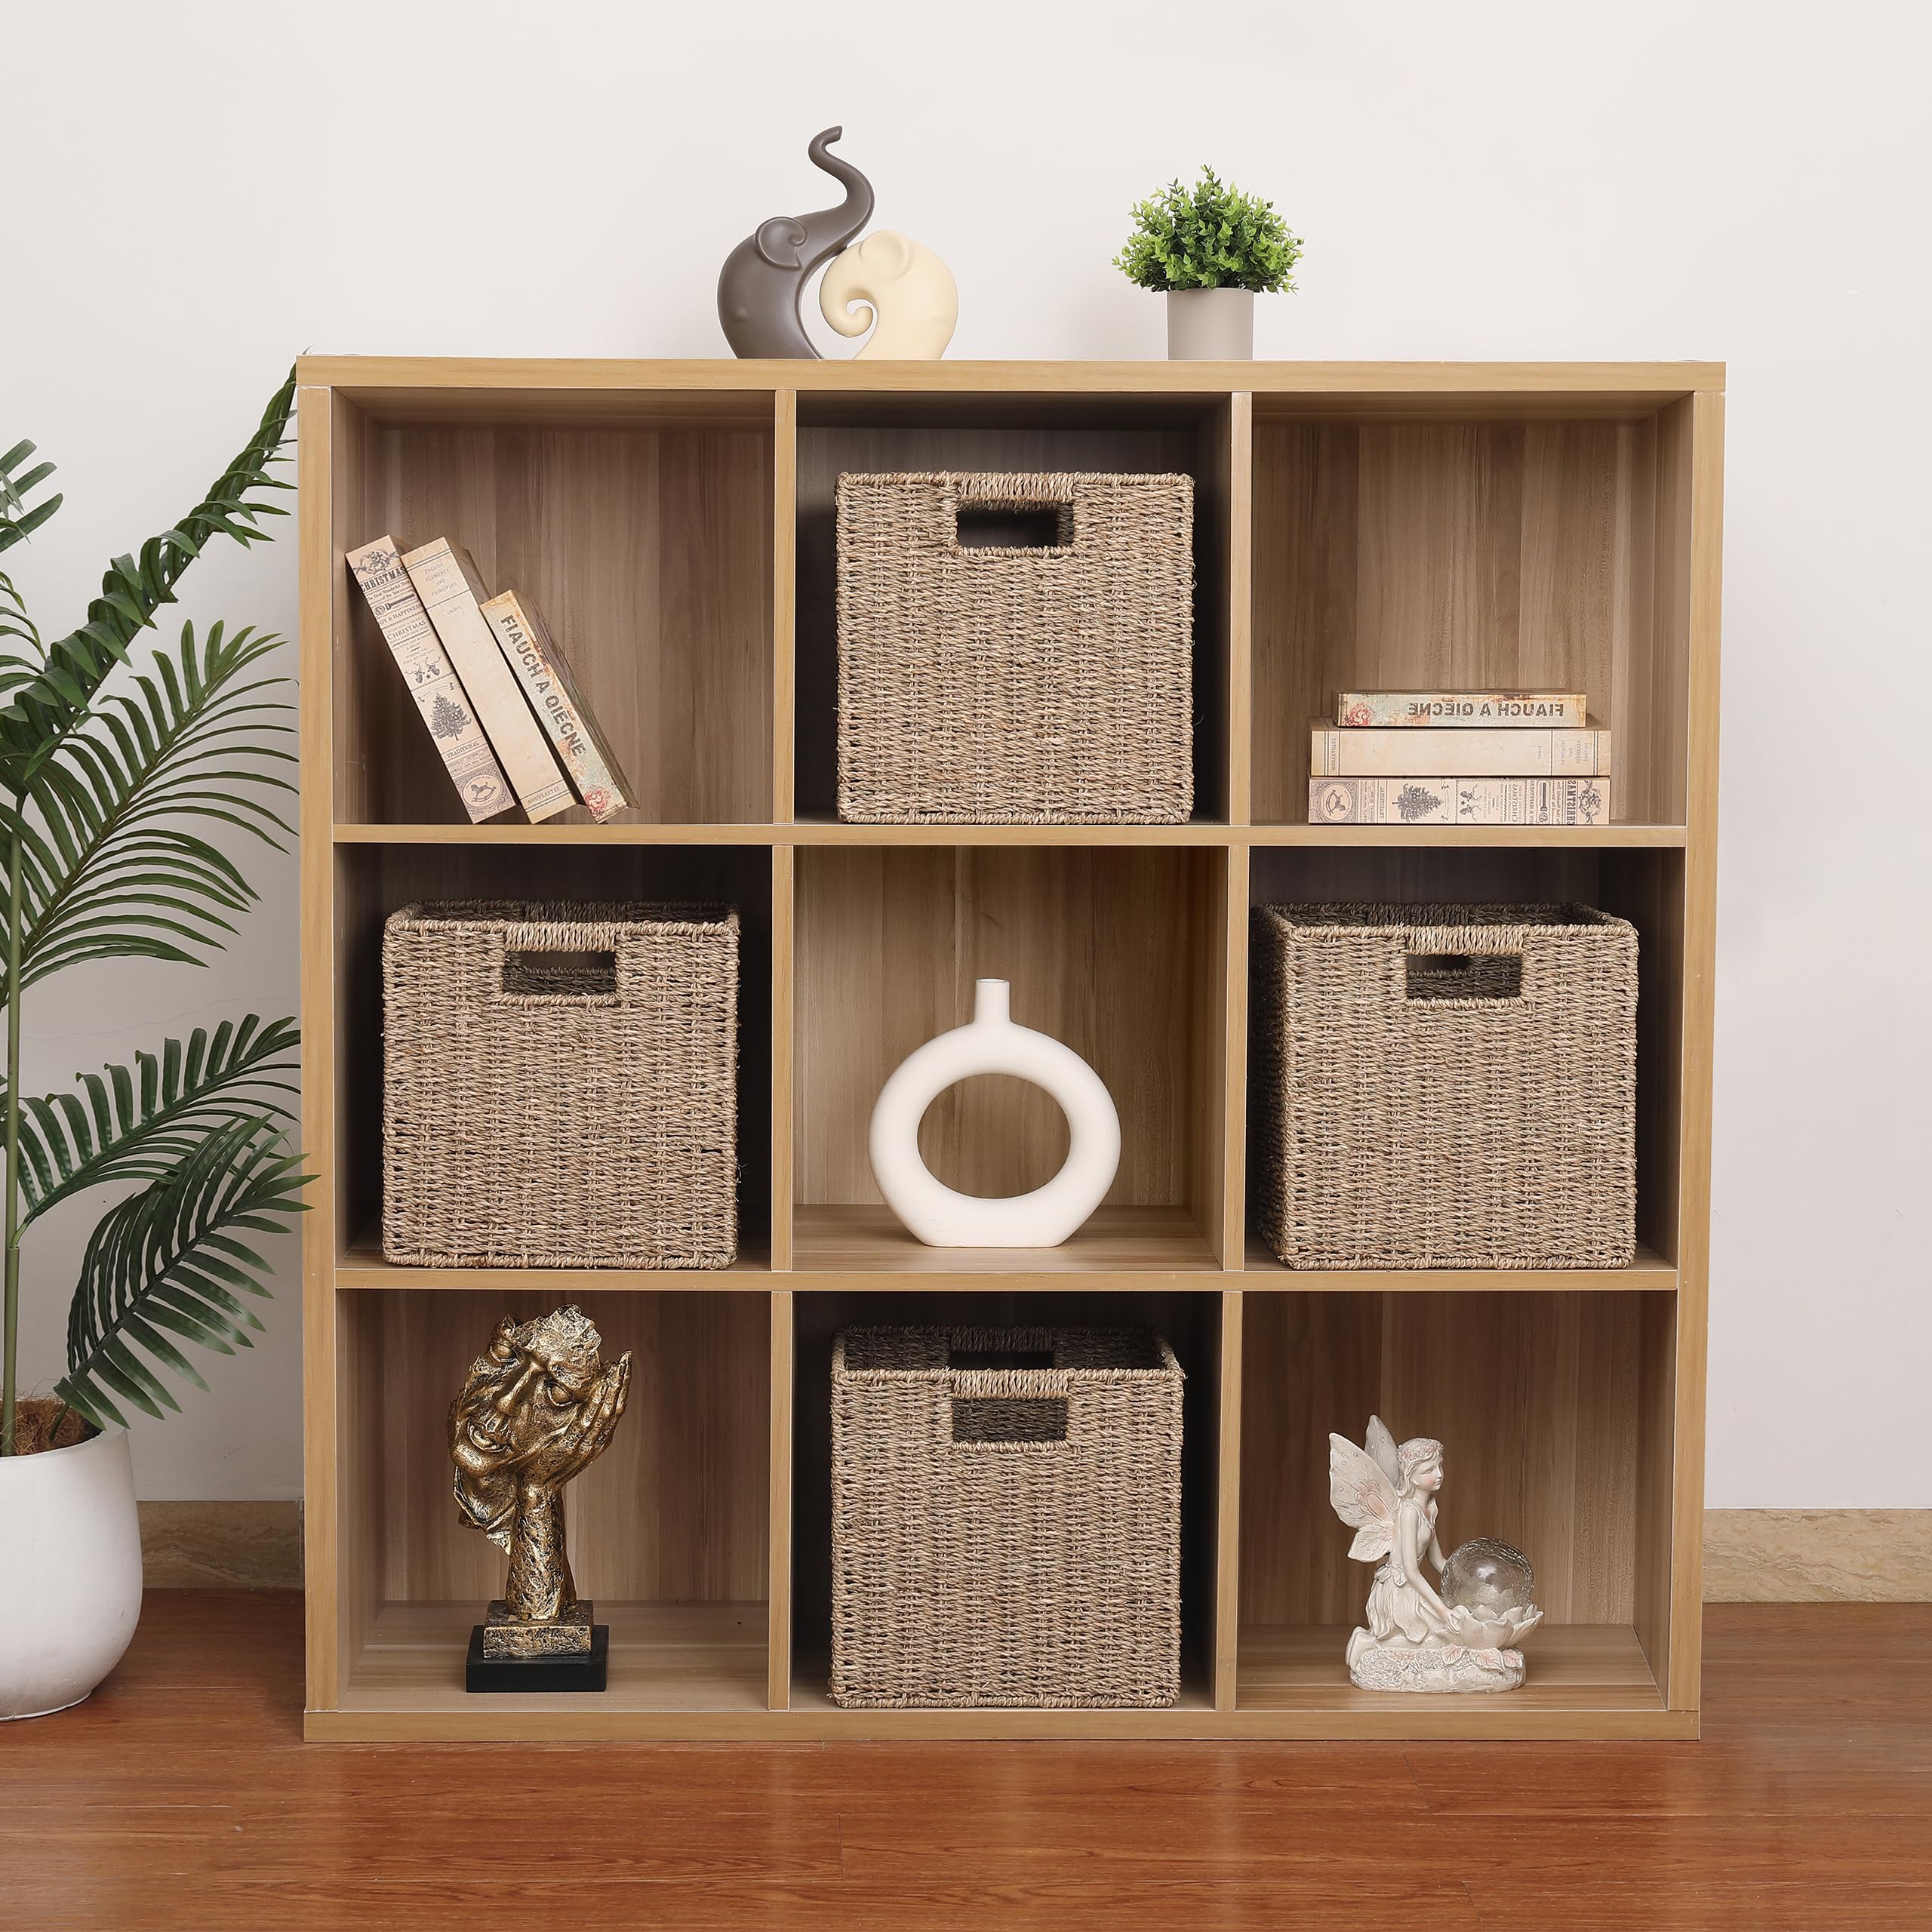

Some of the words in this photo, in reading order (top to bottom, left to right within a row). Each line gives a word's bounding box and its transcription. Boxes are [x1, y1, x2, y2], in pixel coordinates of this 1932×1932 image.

[423, 561, 444, 574] ENGLISH
[425, 568, 449, 581] ELEMENTS
[359, 565, 406, 592] CHRISTMAS
[435, 577, 446, 586] AND
[430, 582, 457, 596] PRINCIPLES
[386, 618, 426, 641] CHRISTMAS
[500, 614, 543, 678] FIAUCH
[536, 681, 551, 694] A
[446, 740, 479, 758] TRADITIONAL
[526, 786, 560, 804] NOUVEAUTES
